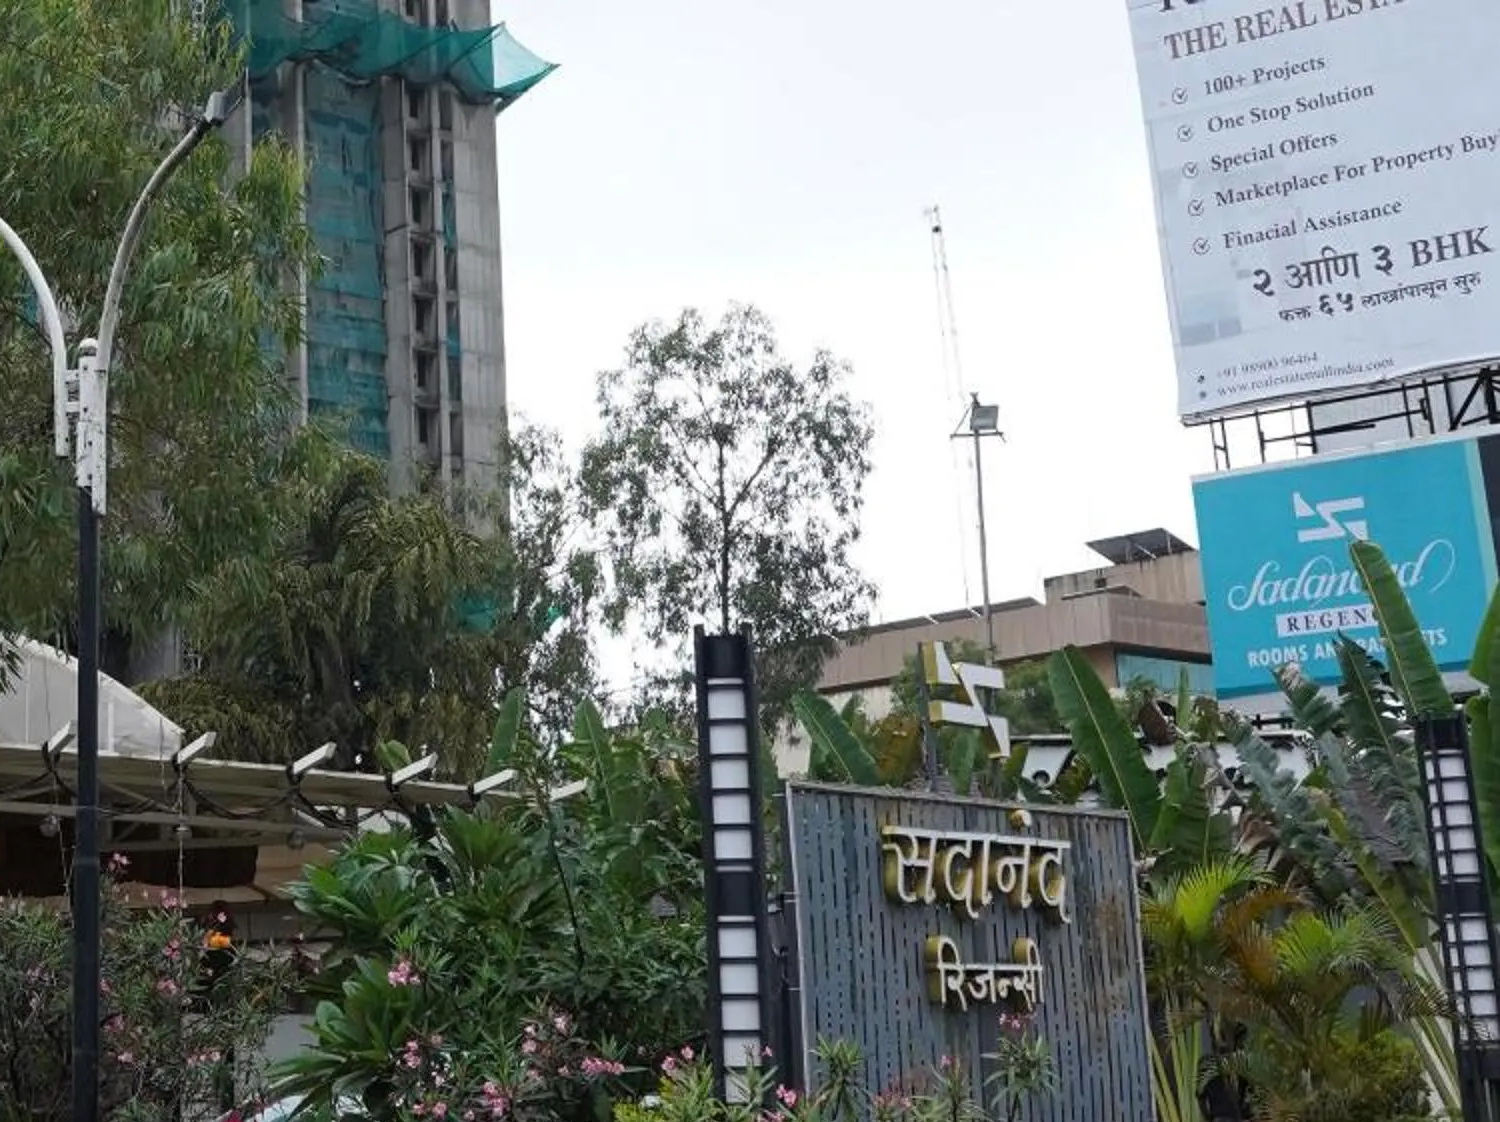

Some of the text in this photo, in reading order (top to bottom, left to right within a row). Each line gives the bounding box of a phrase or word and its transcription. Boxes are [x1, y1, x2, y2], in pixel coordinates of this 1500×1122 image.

[1163, 0, 1404, 60] THE REAL ES
[1204, 57, 1326, 95] 100+ Projects
[1207, 84, 1375, 132] One Stop Solution
[1211, 133, 1338, 173] Special Offers
[1215, 131, 1500, 207] Marketplace For Property Buy
[1223, 200, 1402, 249] Finacial Assistance
[1284, 245, 1361, 289] आणि
[1371, 244, 1395, 276] ३
[1408, 226, 1494, 268] BHK
[1285, 607, 1378, 634] REGEN
[1247, 643, 1308, 668] ROOMS
[882, 808, 1072, 924] सदानंद
